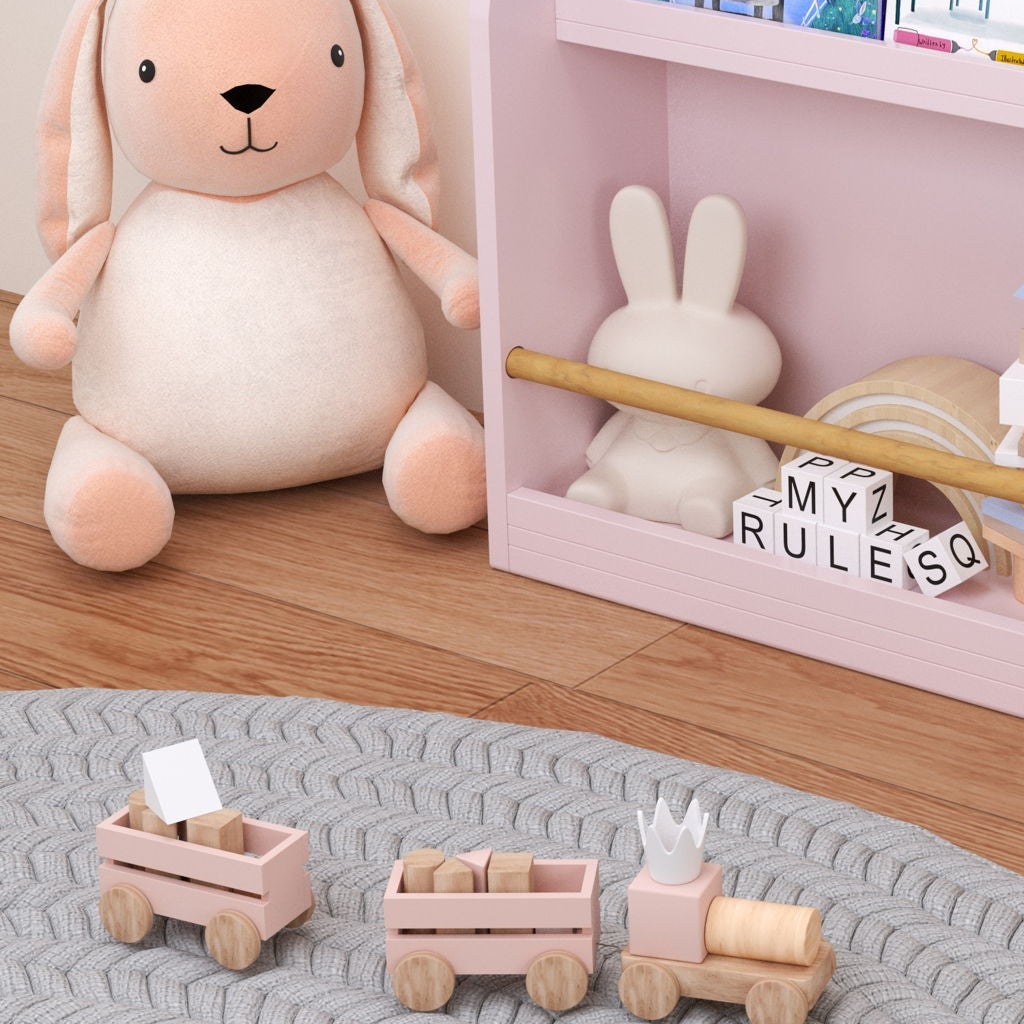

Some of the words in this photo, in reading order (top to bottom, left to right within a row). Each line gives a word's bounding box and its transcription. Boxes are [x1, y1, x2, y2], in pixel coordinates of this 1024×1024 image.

[797, 456, 834, 469] P
[839, 467, 877, 479] P
[787, 475, 858, 523] MY
[871, 483, 888, 525] Z
[874, 524, 915, 542] H
[949, 533, 981, 569] Q
